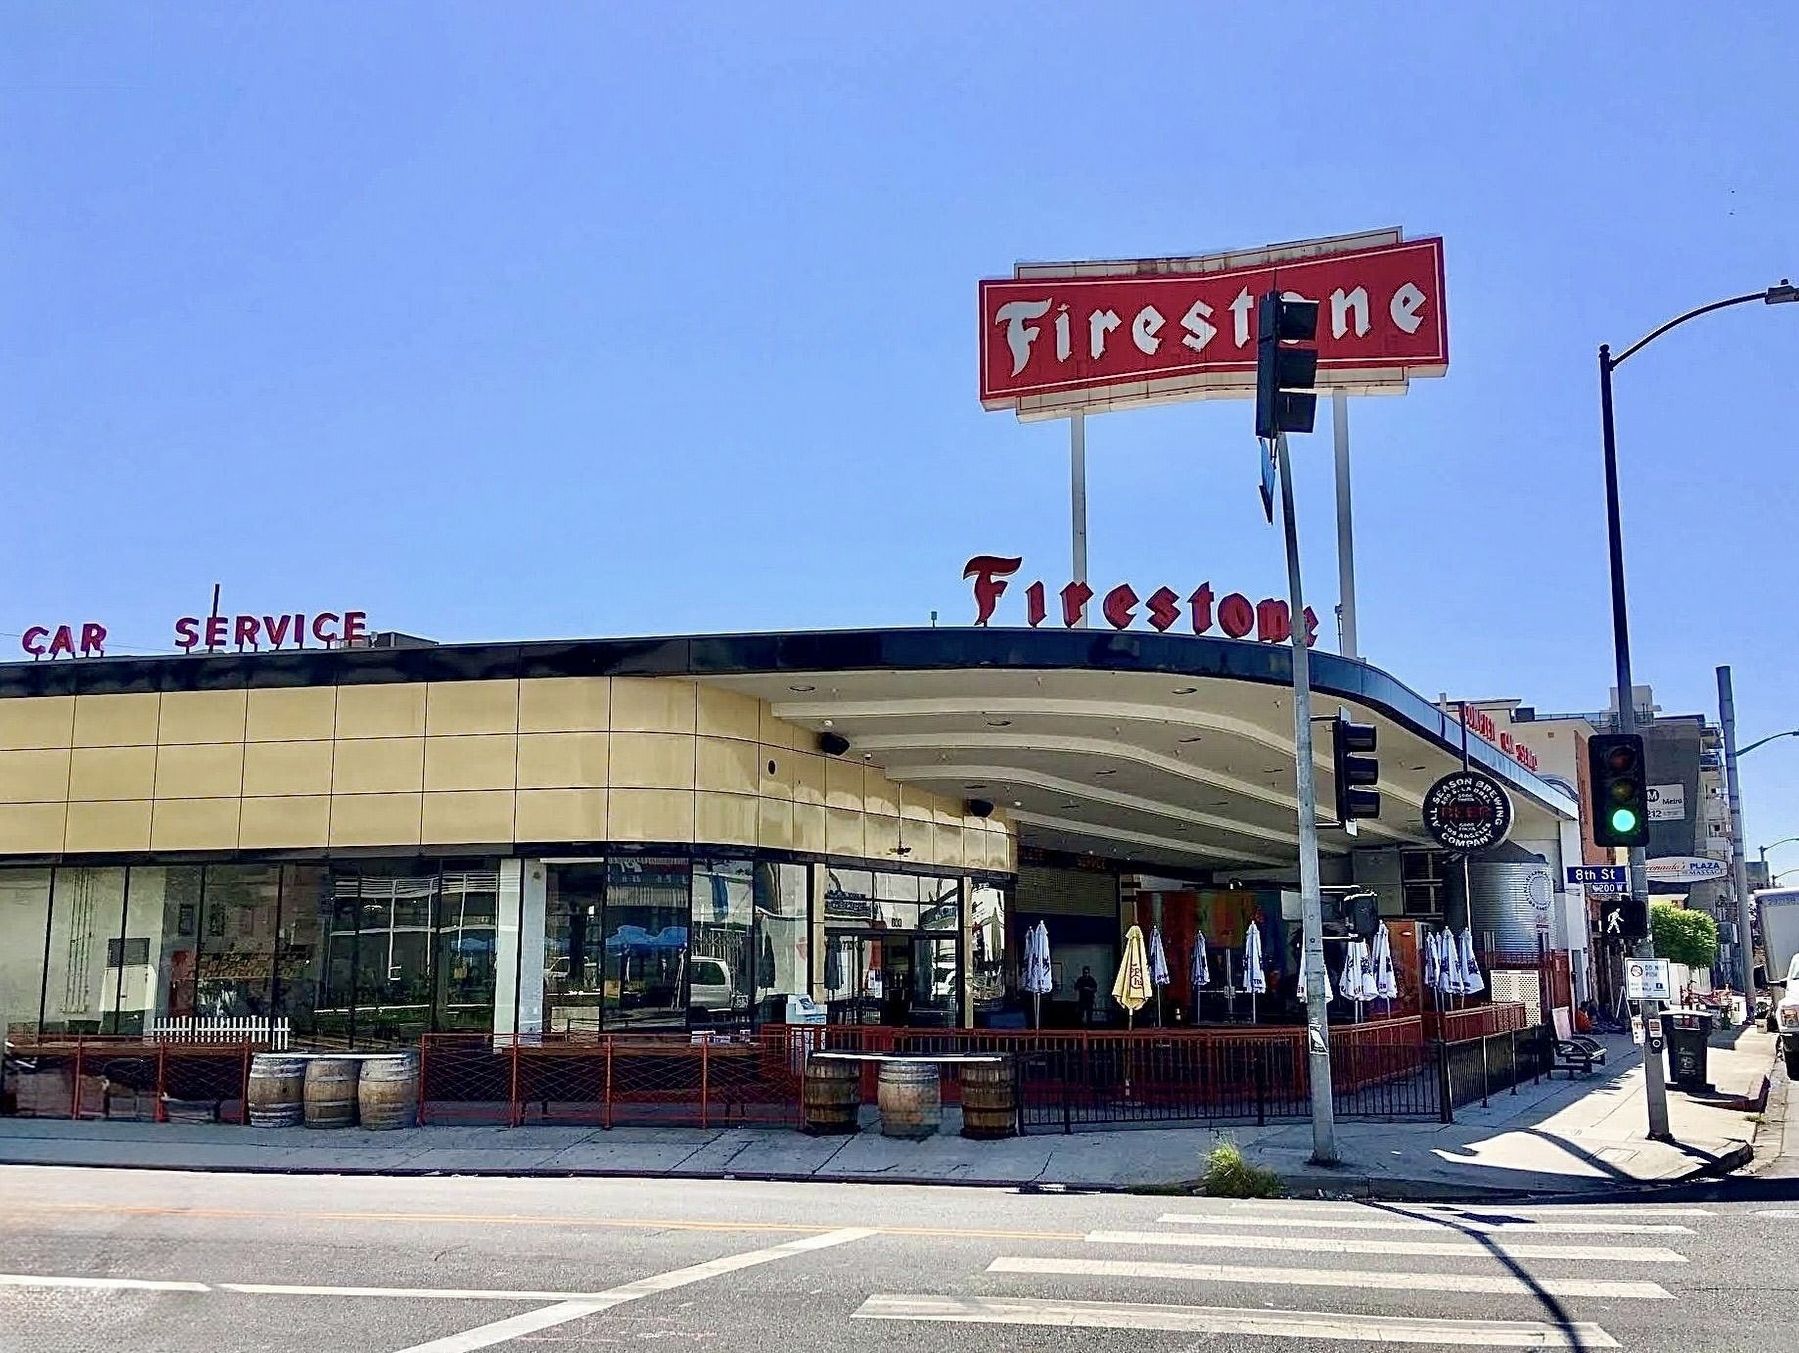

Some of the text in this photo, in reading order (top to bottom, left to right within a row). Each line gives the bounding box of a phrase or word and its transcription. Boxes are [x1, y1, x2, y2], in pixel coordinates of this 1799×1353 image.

[994, 281, 1428, 378] Firestne
[22, 611, 366, 655] CAR SERVICE
[1432, 778, 1472, 804] SEASON
[1475, 780, 1504, 826] BREWING
[1429, 807, 1441, 827] ALL
[1441, 831, 1494, 848] COMPANY
[1443, 823, 1491, 839] LOS ANGELES
[1575, 868, 1616, 881] 8th St
[1689, 862, 1720, 870] PLAZA
[1616, 883, 1623, 892] W
